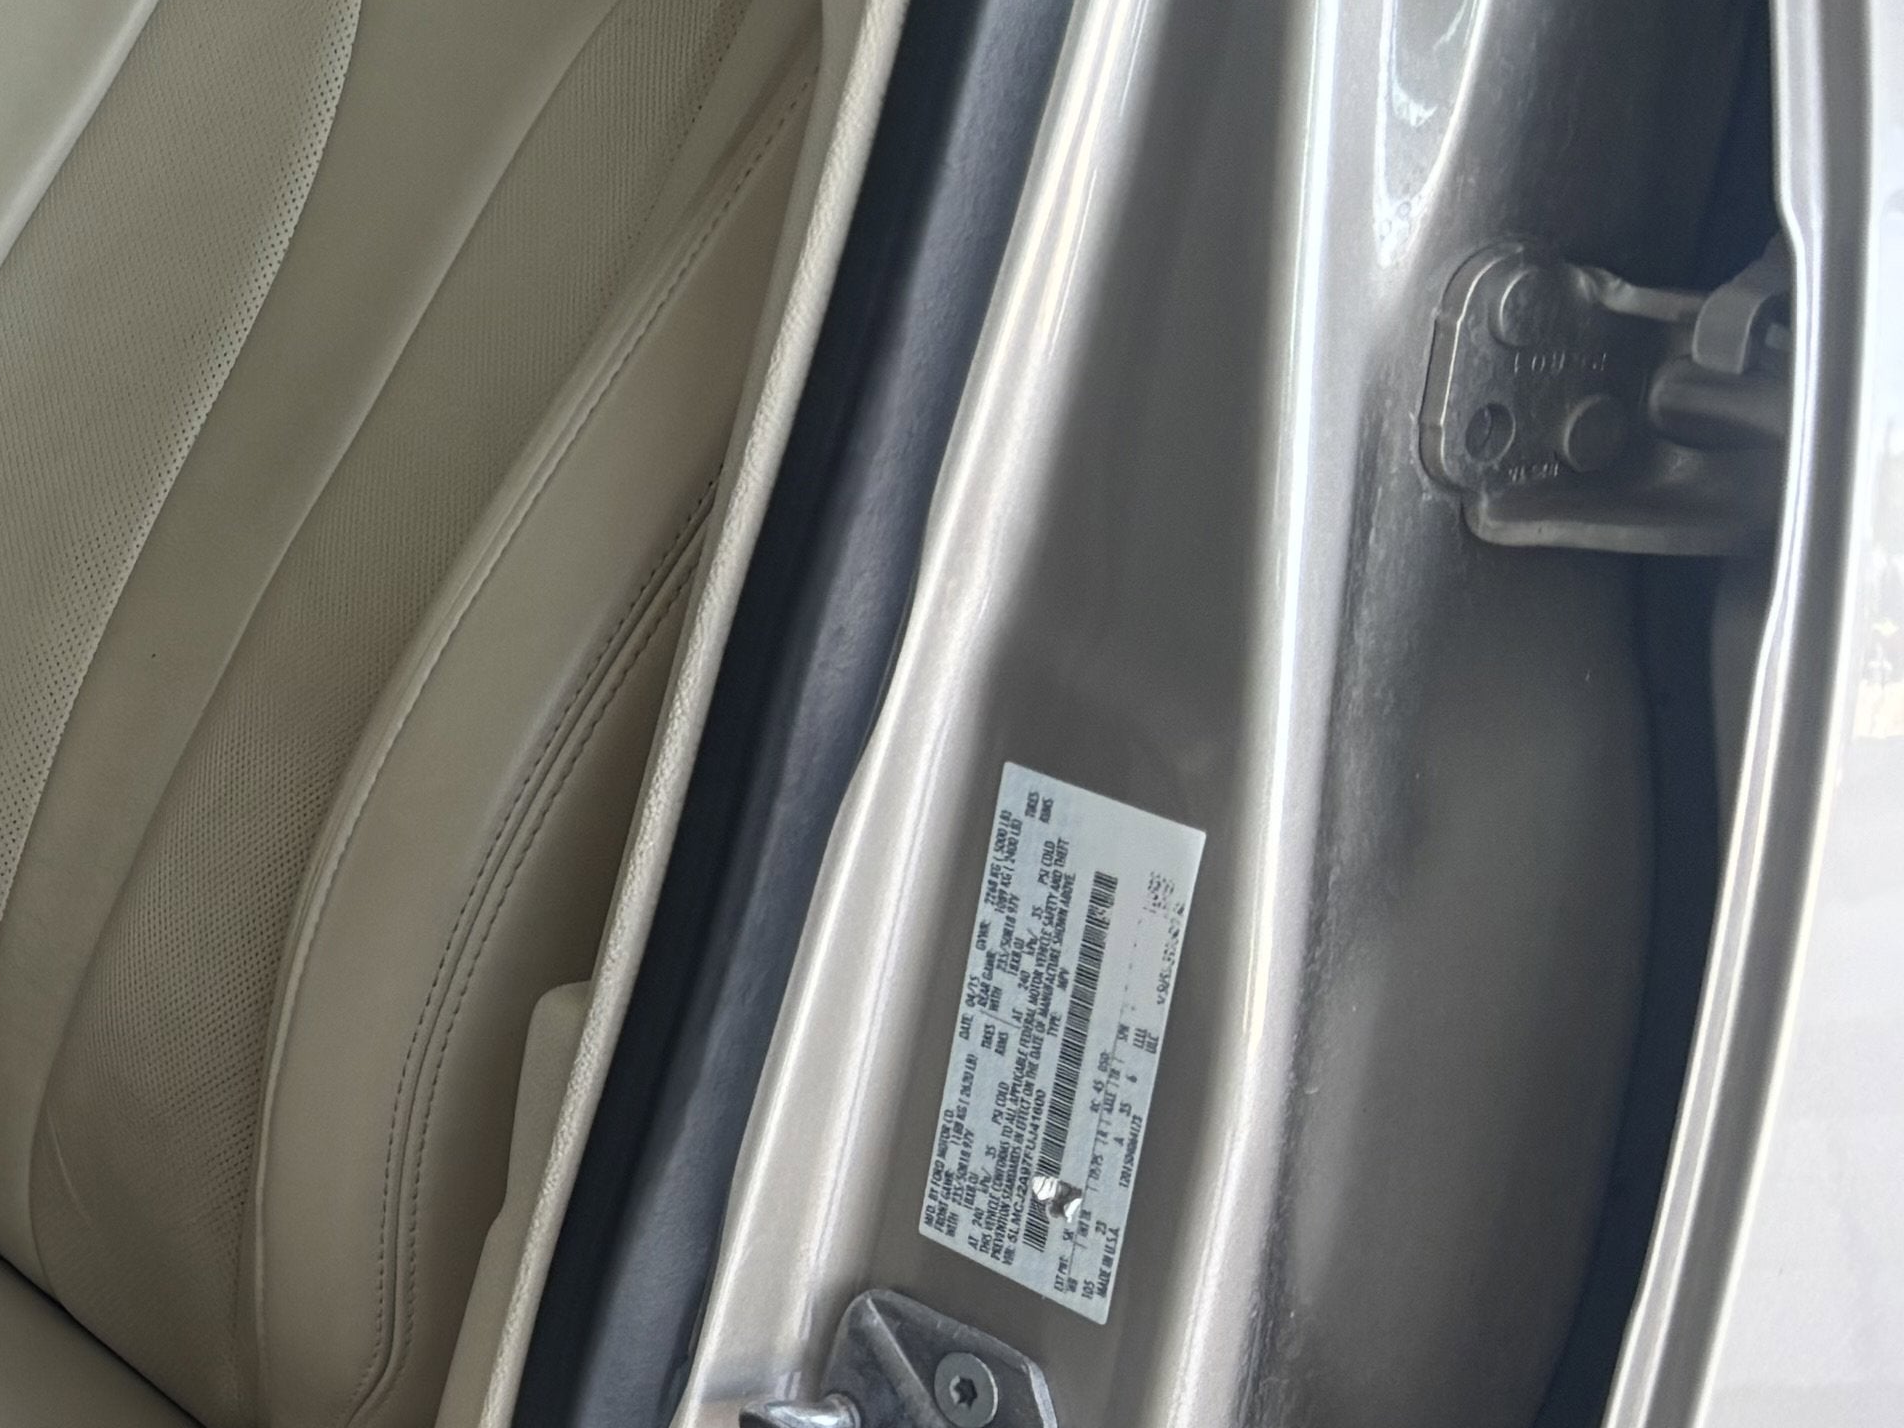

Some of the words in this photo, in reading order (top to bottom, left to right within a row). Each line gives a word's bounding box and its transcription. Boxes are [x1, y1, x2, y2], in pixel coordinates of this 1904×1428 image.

[1053, 837, 1070, 868] THEFT
[989, 862, 1001, 879] KG
[999, 872, 1011, 889] KG
[1050, 869, 1064, 892] AND
[1017, 969, 1030, 991] 240
[1031, 905, 1043, 920] 35
[1040, 840, 1056, 868] COLD
[1042, 891, 1059, 928] SAFETY
[1052, 907, 1068, 947] SHOWN
[1034, 927, 1052, 968] VEHICLE
[1028, 969, 1044, 1006] MOTOR
[1037, 946, 1061, 1019] MANUFACTURE
[1034, 1019, 1046, 1034] OF
[1029, 1034, 1044, 1061] DATE
[1008, 1048, 1029, 1107] APPLICABLE
[1022, 1080, 1035, 1097] ON
[984, 1144, 997, 1160] 35
[994, 1081, 1009, 1108] COLD
[1001, 1124, 1014, 1139] TO
[1004, 1107, 1017, 1125] ALL
[936, 1123, 951, 1160] MOTOR
[930, 1159, 944, 1187] FORD
[934, 1200, 949, 1233] FRONT
[1101, 1254, 1114, 1269] IN
[1096, 1267, 1111, 1298] MADE
